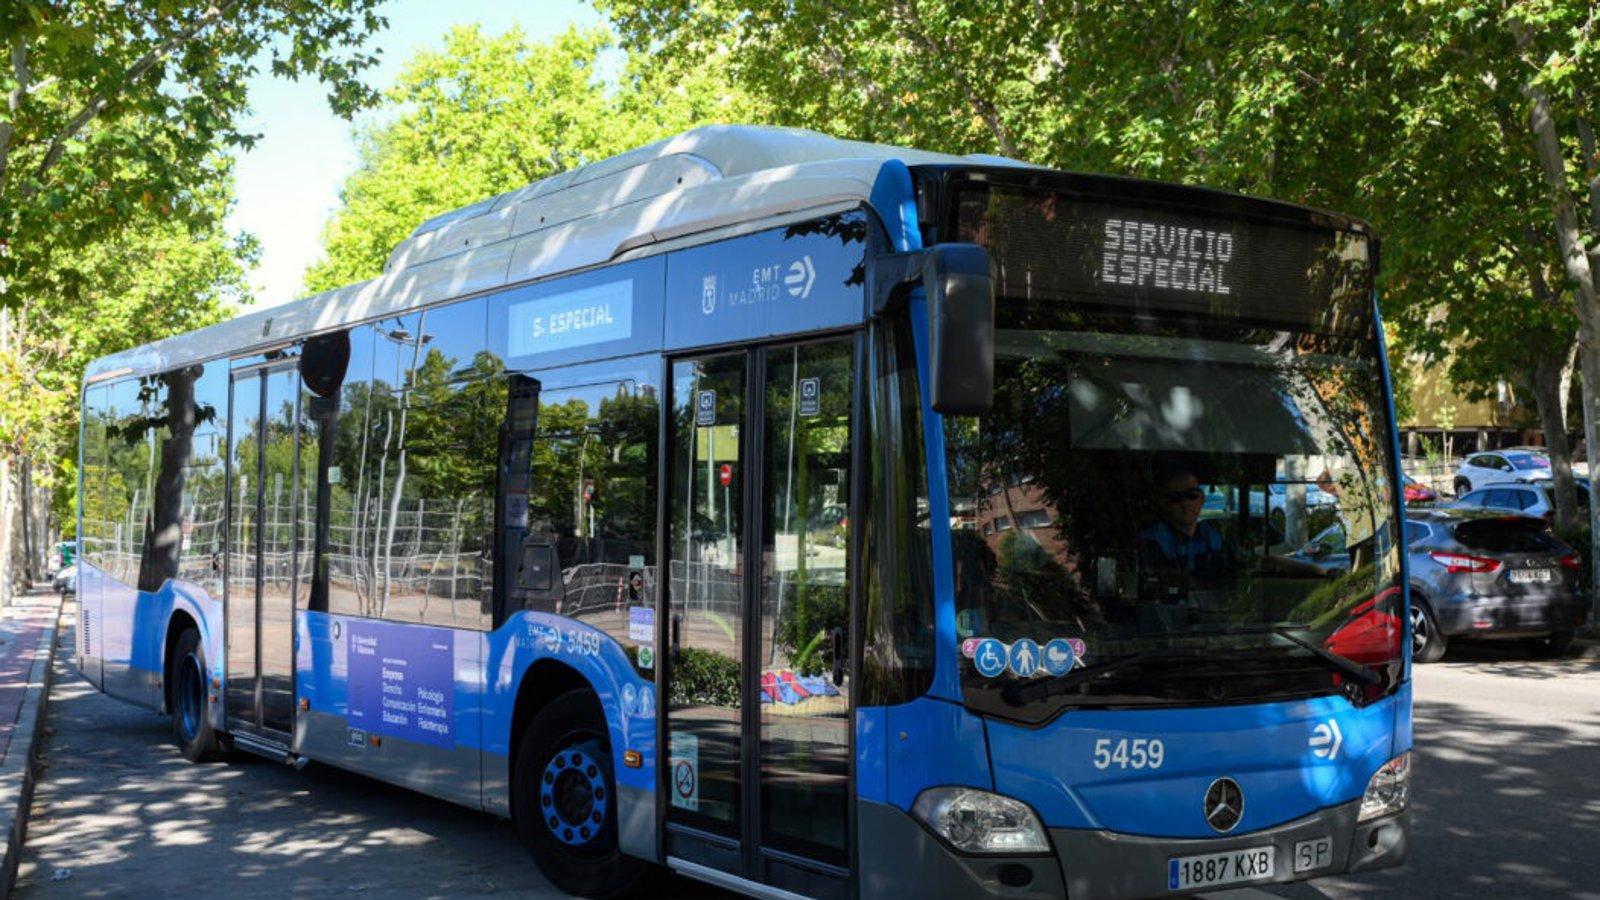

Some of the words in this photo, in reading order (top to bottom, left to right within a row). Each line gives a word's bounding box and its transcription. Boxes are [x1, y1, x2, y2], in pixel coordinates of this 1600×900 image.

[1104, 219, 1233, 262] SERVICIO
[752, 265, 780, 285] EMT
[1102, 252, 1230, 295] ESPECIAL
[729, 284, 780, 305] MADRID
[549, 304, 613, 334] ESPECIAL
[567, 630, 600, 656] 5459
[966, 641, 974, 652] 2
[1074, 641, 1081, 652] 4
[1093, 739, 1164, 769] 5459
[1302, 841, 1328, 867] SP
[1183, 857, 1230, 885] 1887
[1235, 852, 1269, 881] KXB
